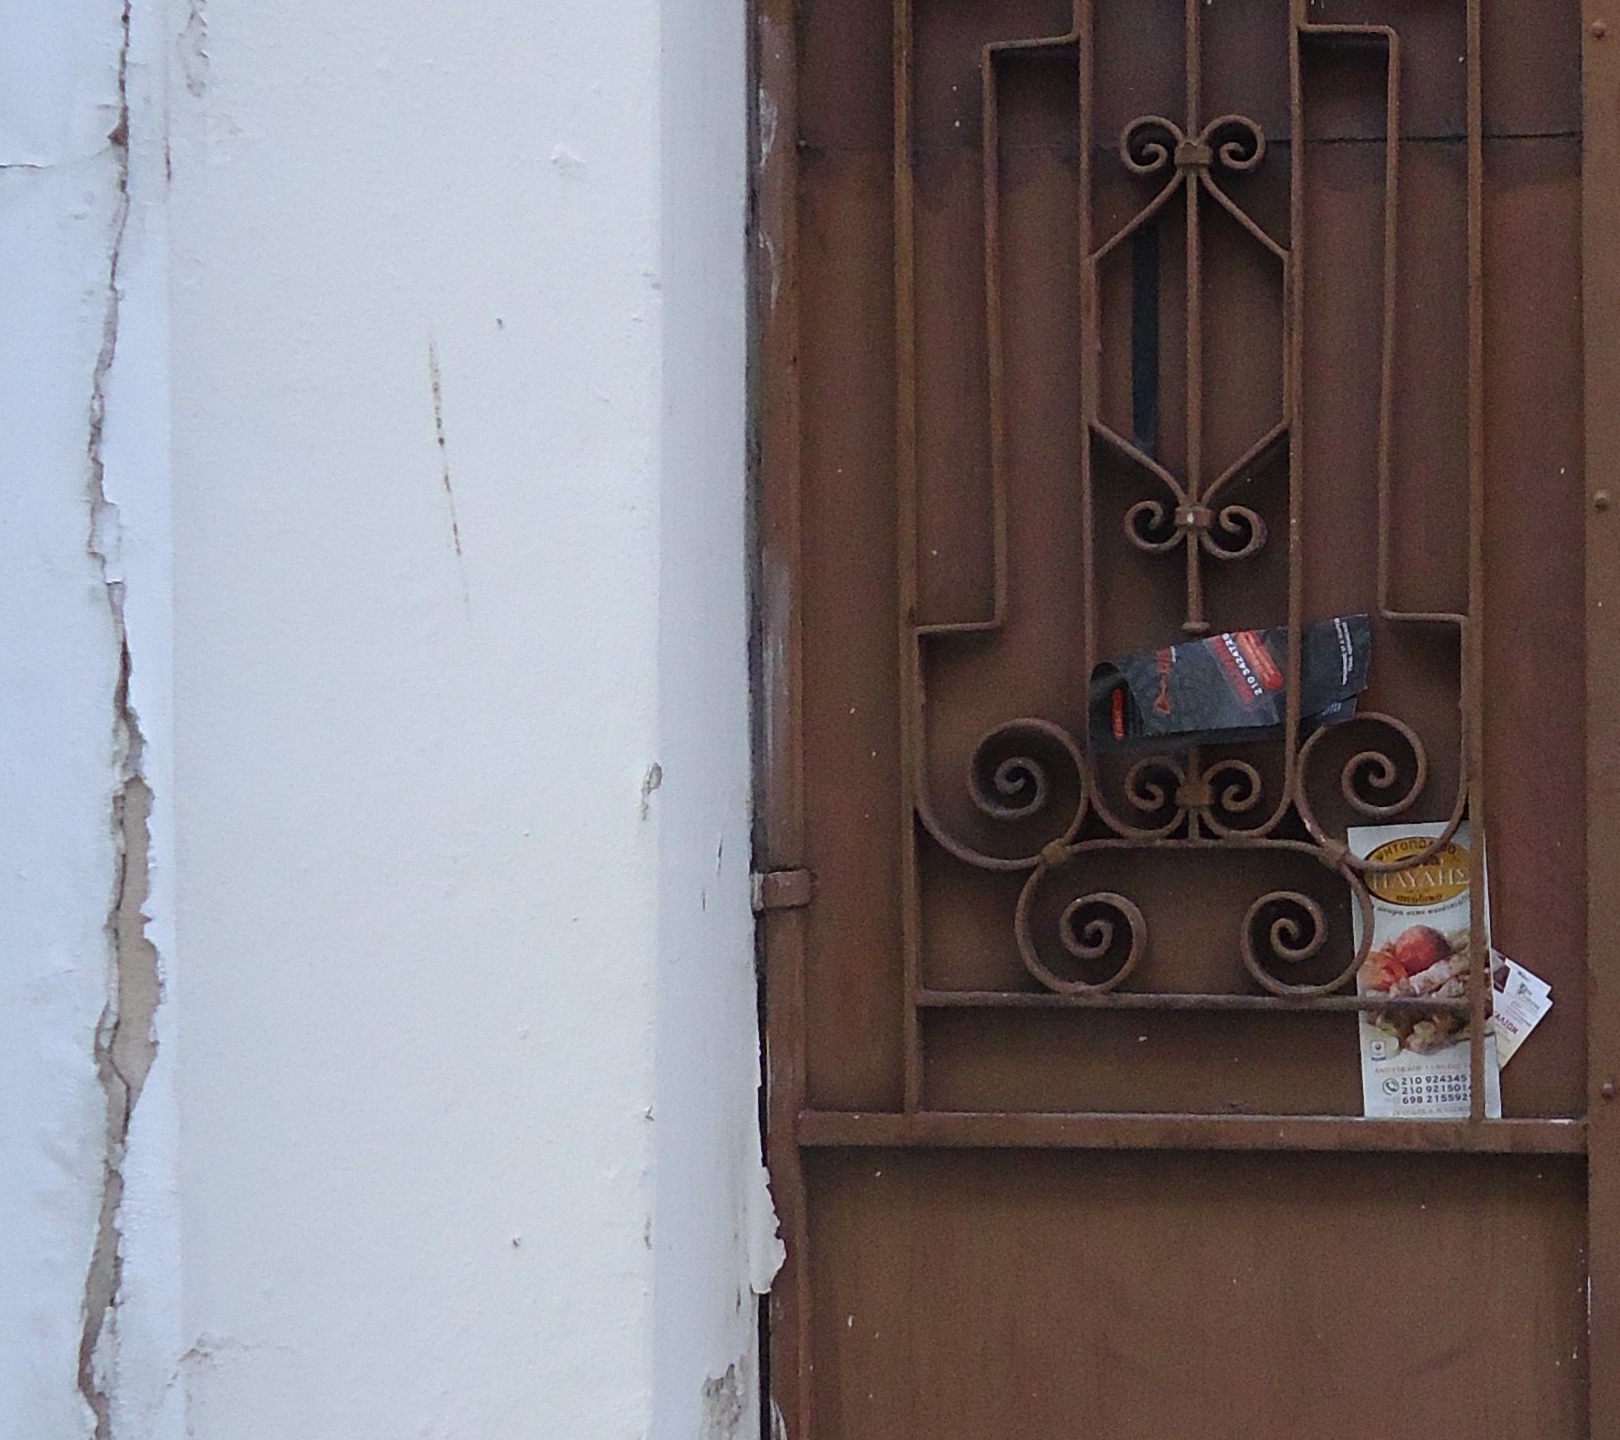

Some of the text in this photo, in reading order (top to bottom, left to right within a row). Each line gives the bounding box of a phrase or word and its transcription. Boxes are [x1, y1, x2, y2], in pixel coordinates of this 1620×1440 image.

[1247, 676, 1263, 696] 210
[1401, 1074, 1468, 1086] 210 924345
[1401, 1084, 1471, 1095] 210 921501
[1402, 1093, 1471, 1104] 698 215592
